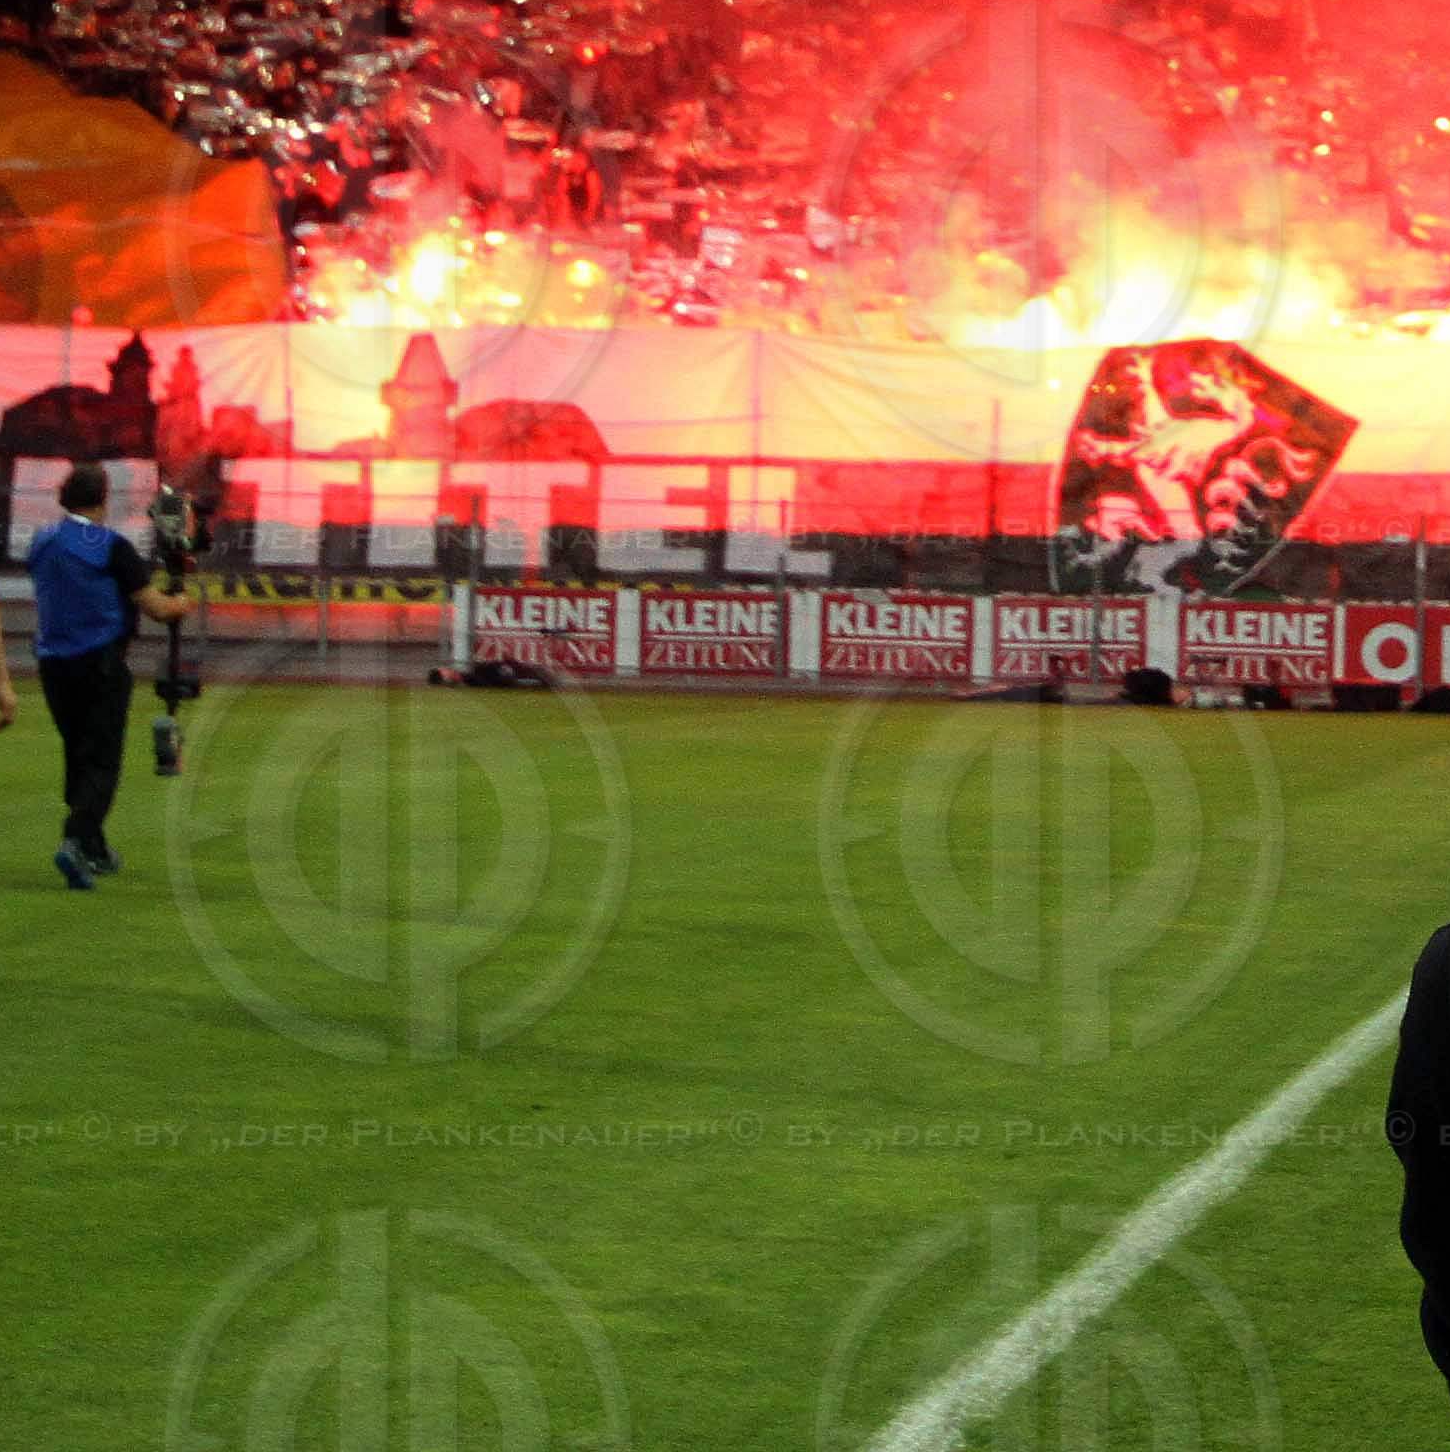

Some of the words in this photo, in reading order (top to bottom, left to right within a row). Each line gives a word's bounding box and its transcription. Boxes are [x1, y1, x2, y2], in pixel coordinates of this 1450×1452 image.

[220, 456, 832, 576] TITEL
[476, 594, 611, 631] KLEINE
[647, 598, 778, 635] KLEINE
[827, 602, 967, 639] KLEINE
[999, 606, 1140, 642] KLEINE
[1185, 609, 1329, 646] KLEINE
